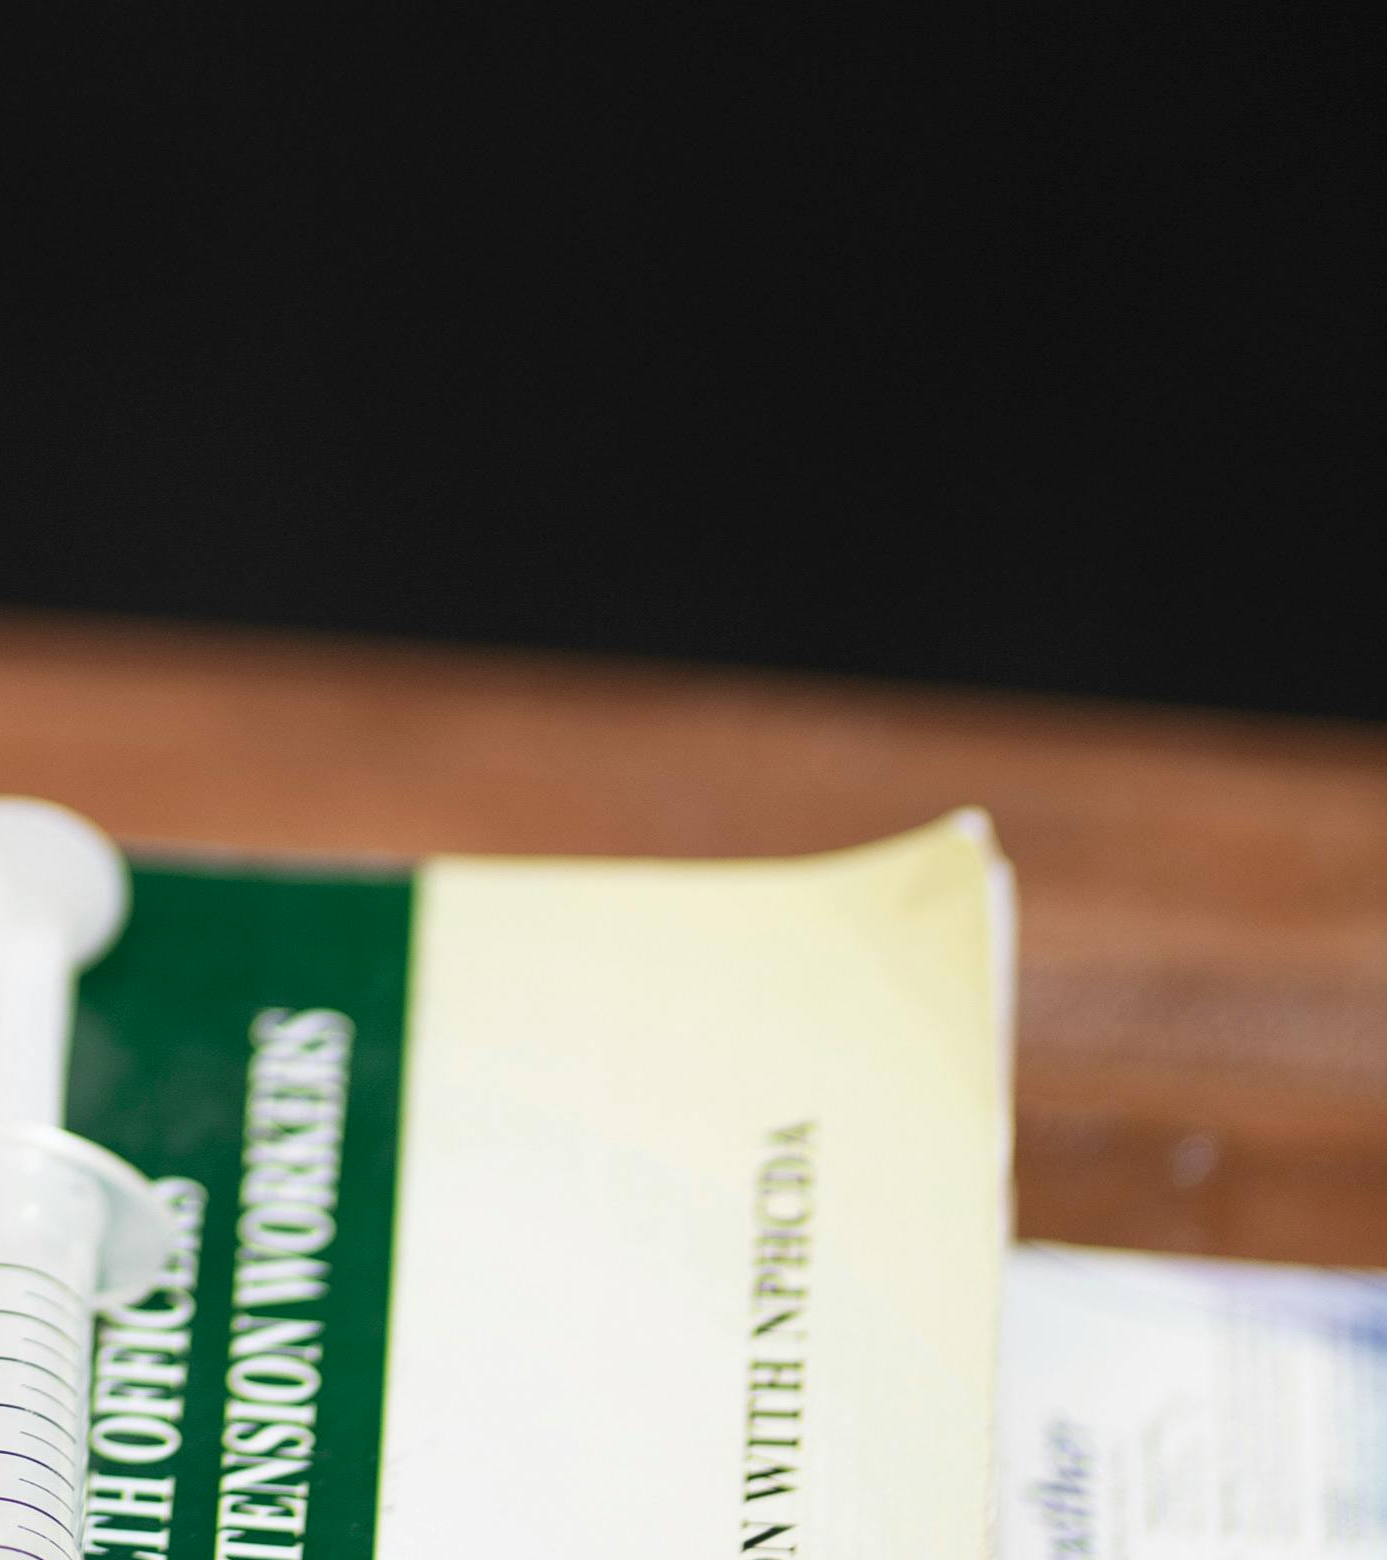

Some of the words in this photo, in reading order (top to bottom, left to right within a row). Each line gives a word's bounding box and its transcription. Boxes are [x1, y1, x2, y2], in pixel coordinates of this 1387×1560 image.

[232, 1006, 357, 1308] WORKERS
[750, 1117, 821, 1342] NPHCDA
[744, 1359, 805, 1504] WITH
